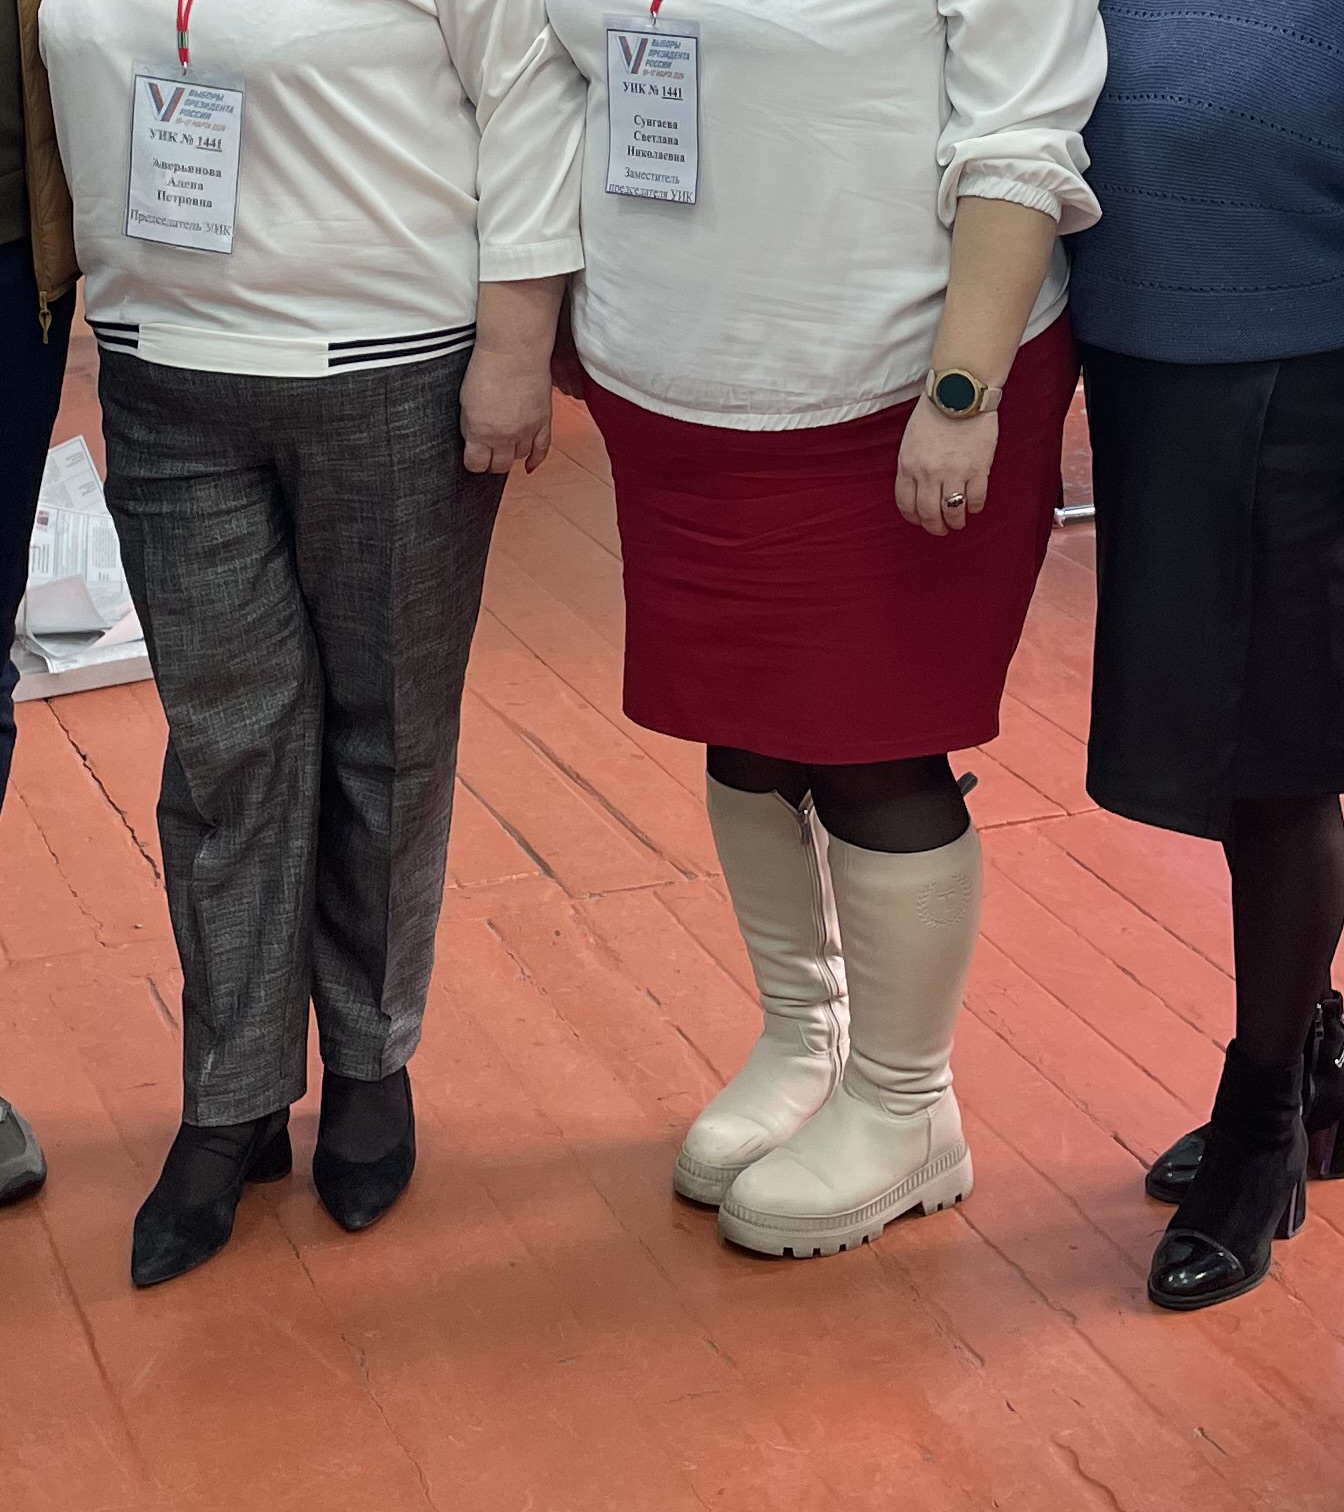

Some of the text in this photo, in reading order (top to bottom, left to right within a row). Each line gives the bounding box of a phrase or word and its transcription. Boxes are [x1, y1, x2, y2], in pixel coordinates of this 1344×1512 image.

[623, 81, 646, 95] УИК
[662, 85, 683, 99] 1441
[150, 128, 178, 143] УИК
[197, 136, 222, 151] 1441
[633, 130, 679, 146] Светлана
[627, 145, 686, 163] Николаевна
[153, 158, 222, 178] Аверьянова
[624, 166, 680, 184] Заместитель
[156, 189, 213, 208] Петровна
[670, 189, 694, 203] УИК
[205, 222, 232, 236] УИК
